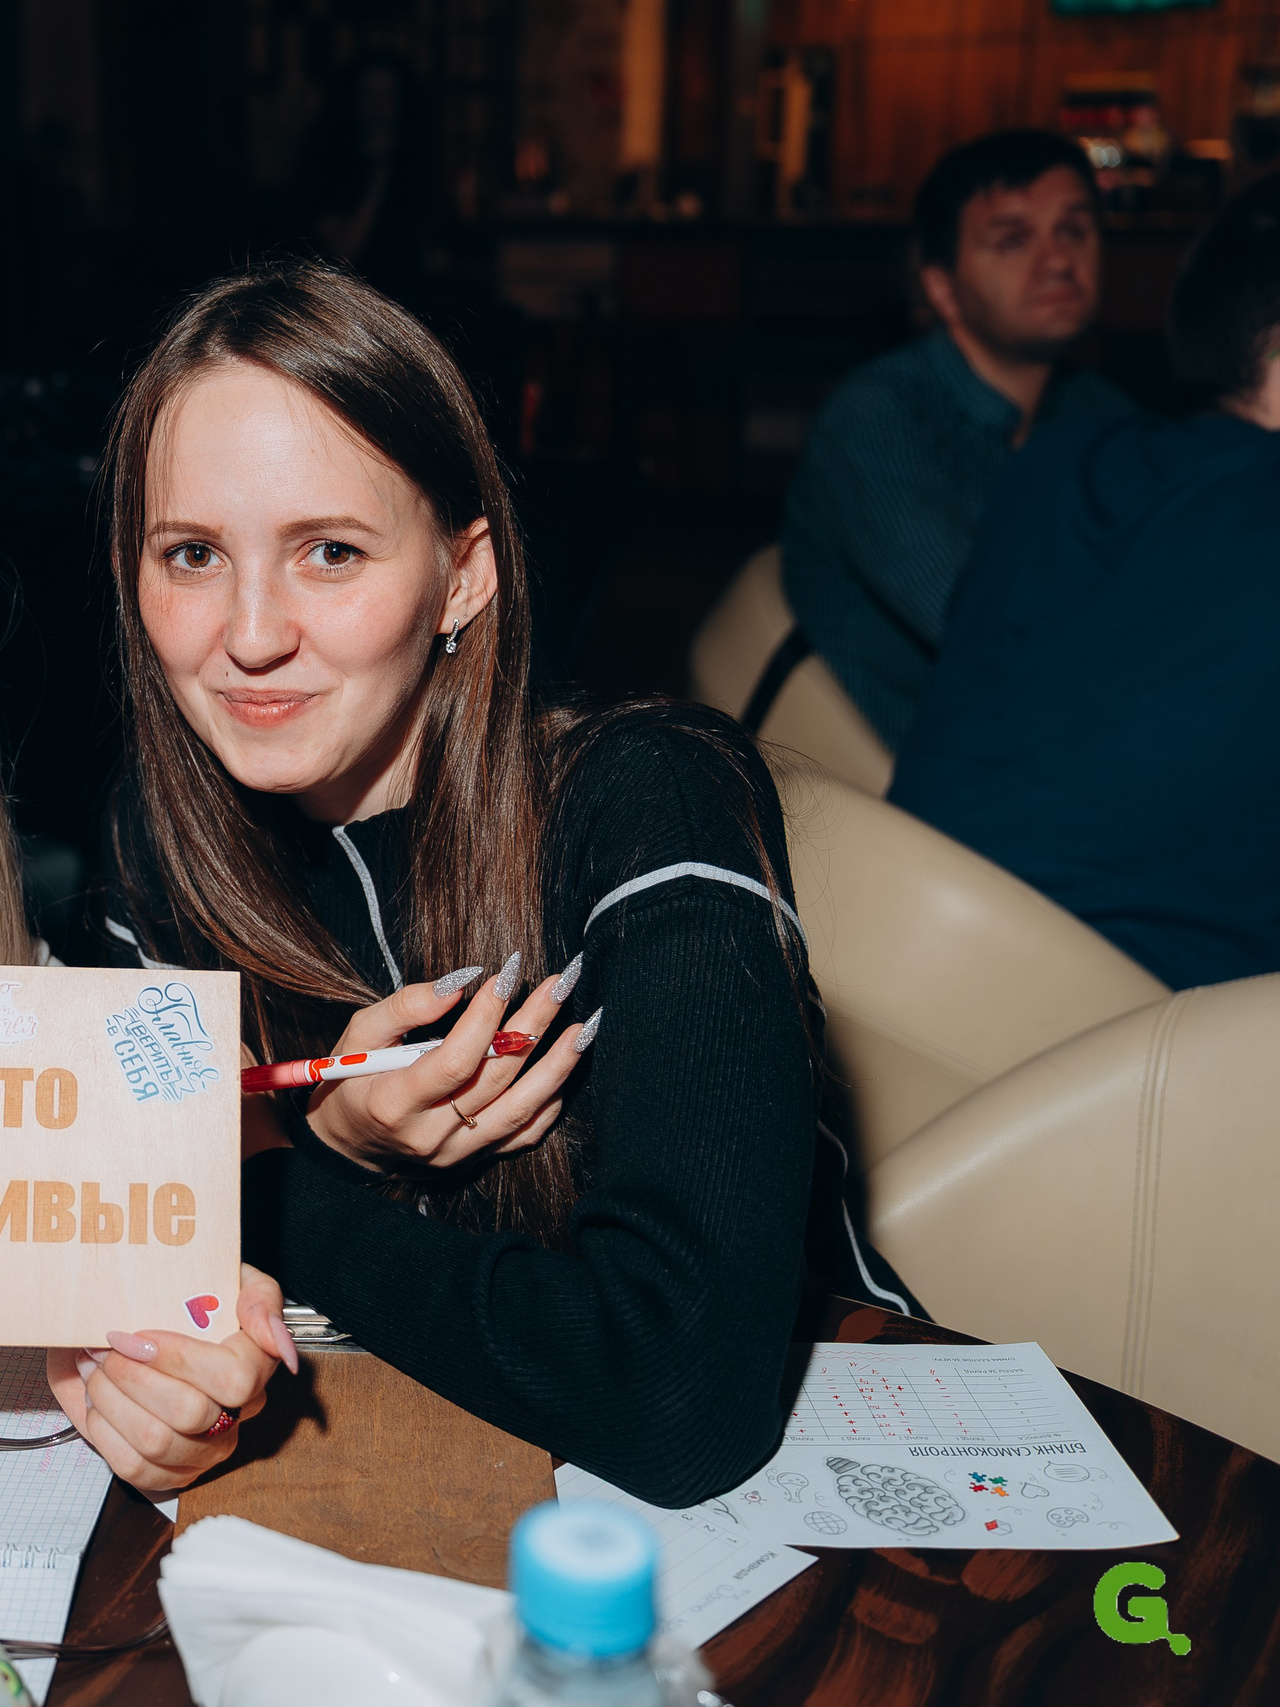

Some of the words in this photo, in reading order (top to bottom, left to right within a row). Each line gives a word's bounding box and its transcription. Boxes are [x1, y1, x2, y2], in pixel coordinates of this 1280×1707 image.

[130, 1024, 174, 1082] ВЕРИТЬ
[113, 1038, 160, 1102] СЕБЯ
[908, 1446, 1031, 1457] САМОКОНТРОЛЯ
[1032, 1443, 1087, 1455] БЛАНК
[732, 1550, 778, 1580] Команда
